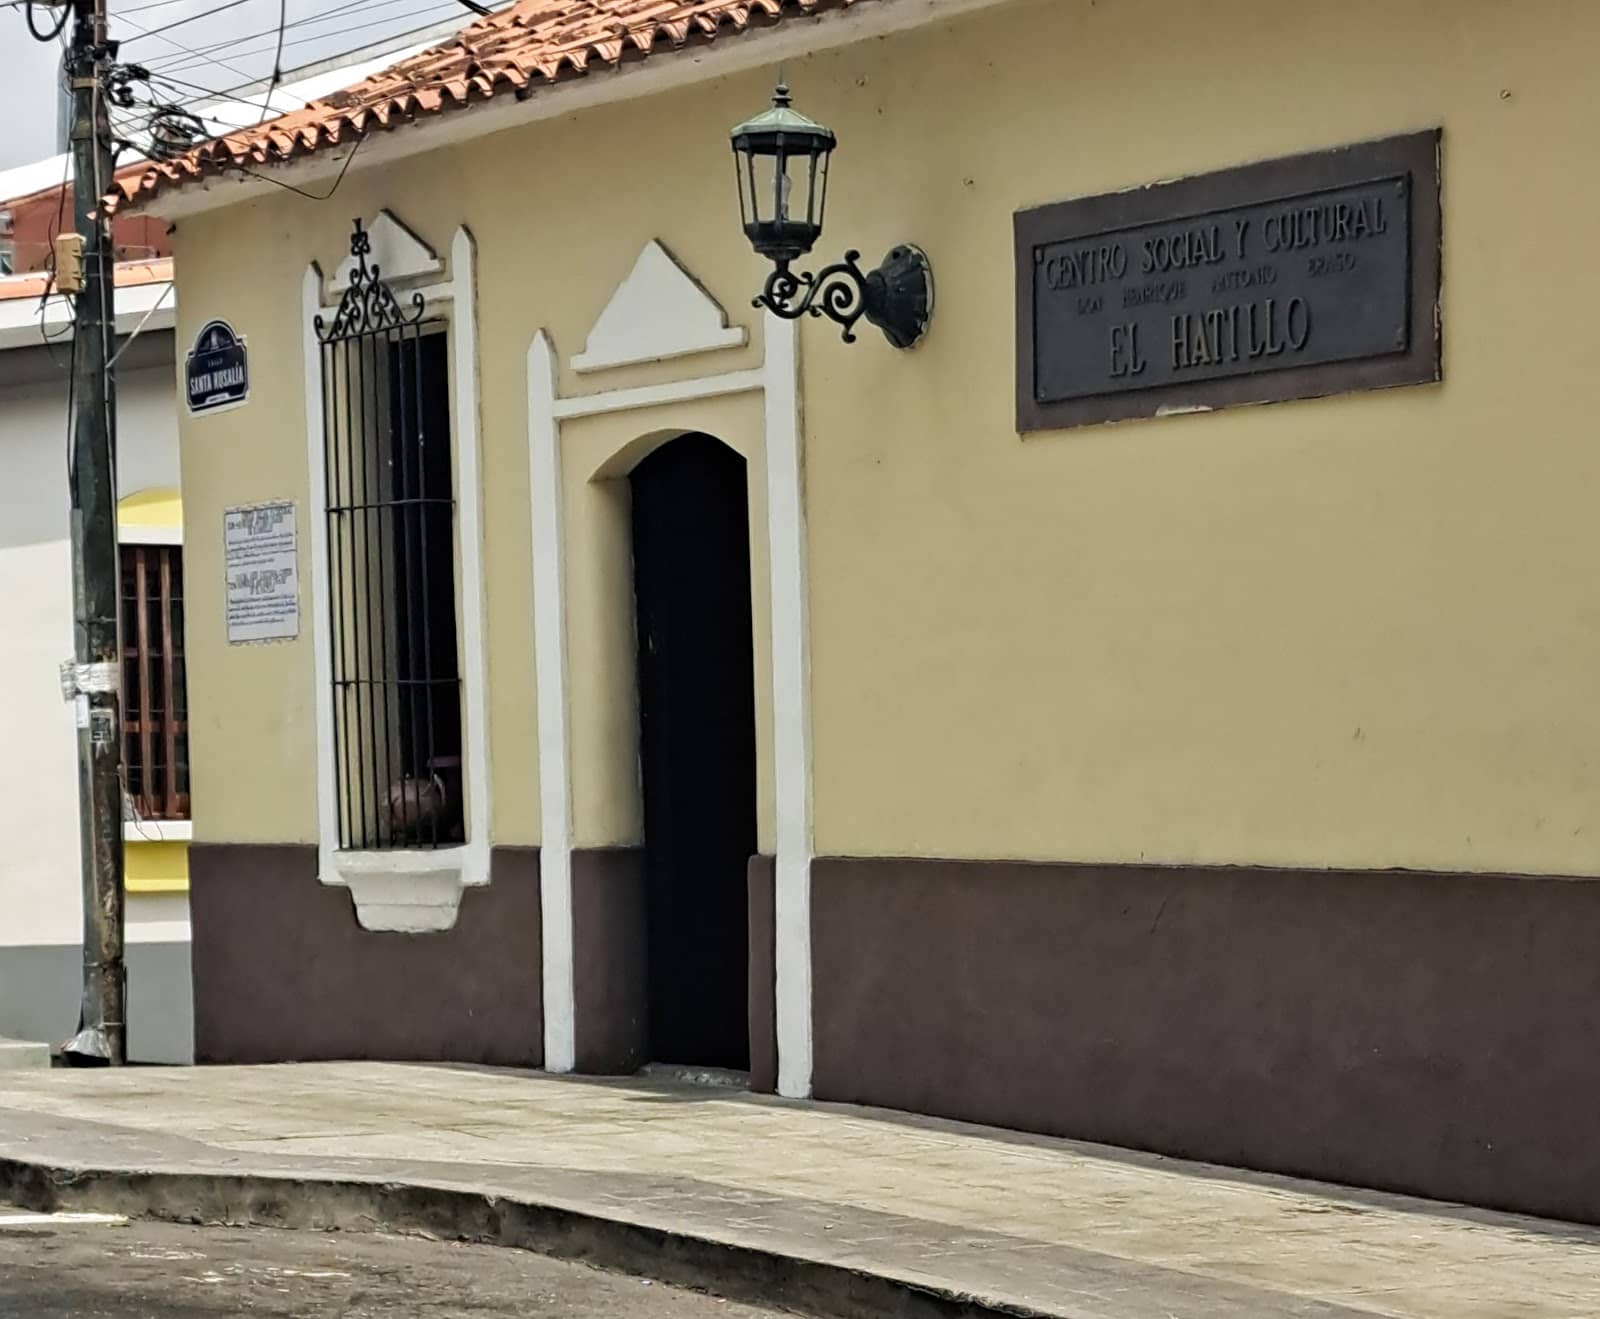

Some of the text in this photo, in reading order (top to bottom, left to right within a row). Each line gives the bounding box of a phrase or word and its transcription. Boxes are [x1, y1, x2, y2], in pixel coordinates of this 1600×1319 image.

[1047, 199, 1387, 290] CENTRO SOCIAL Y CULTURAL
[1212, 266, 1277, 292] ANTONIO
[1109, 297, 1312, 378] EL HATILLO
[190, 373, 212, 396] SANTA
